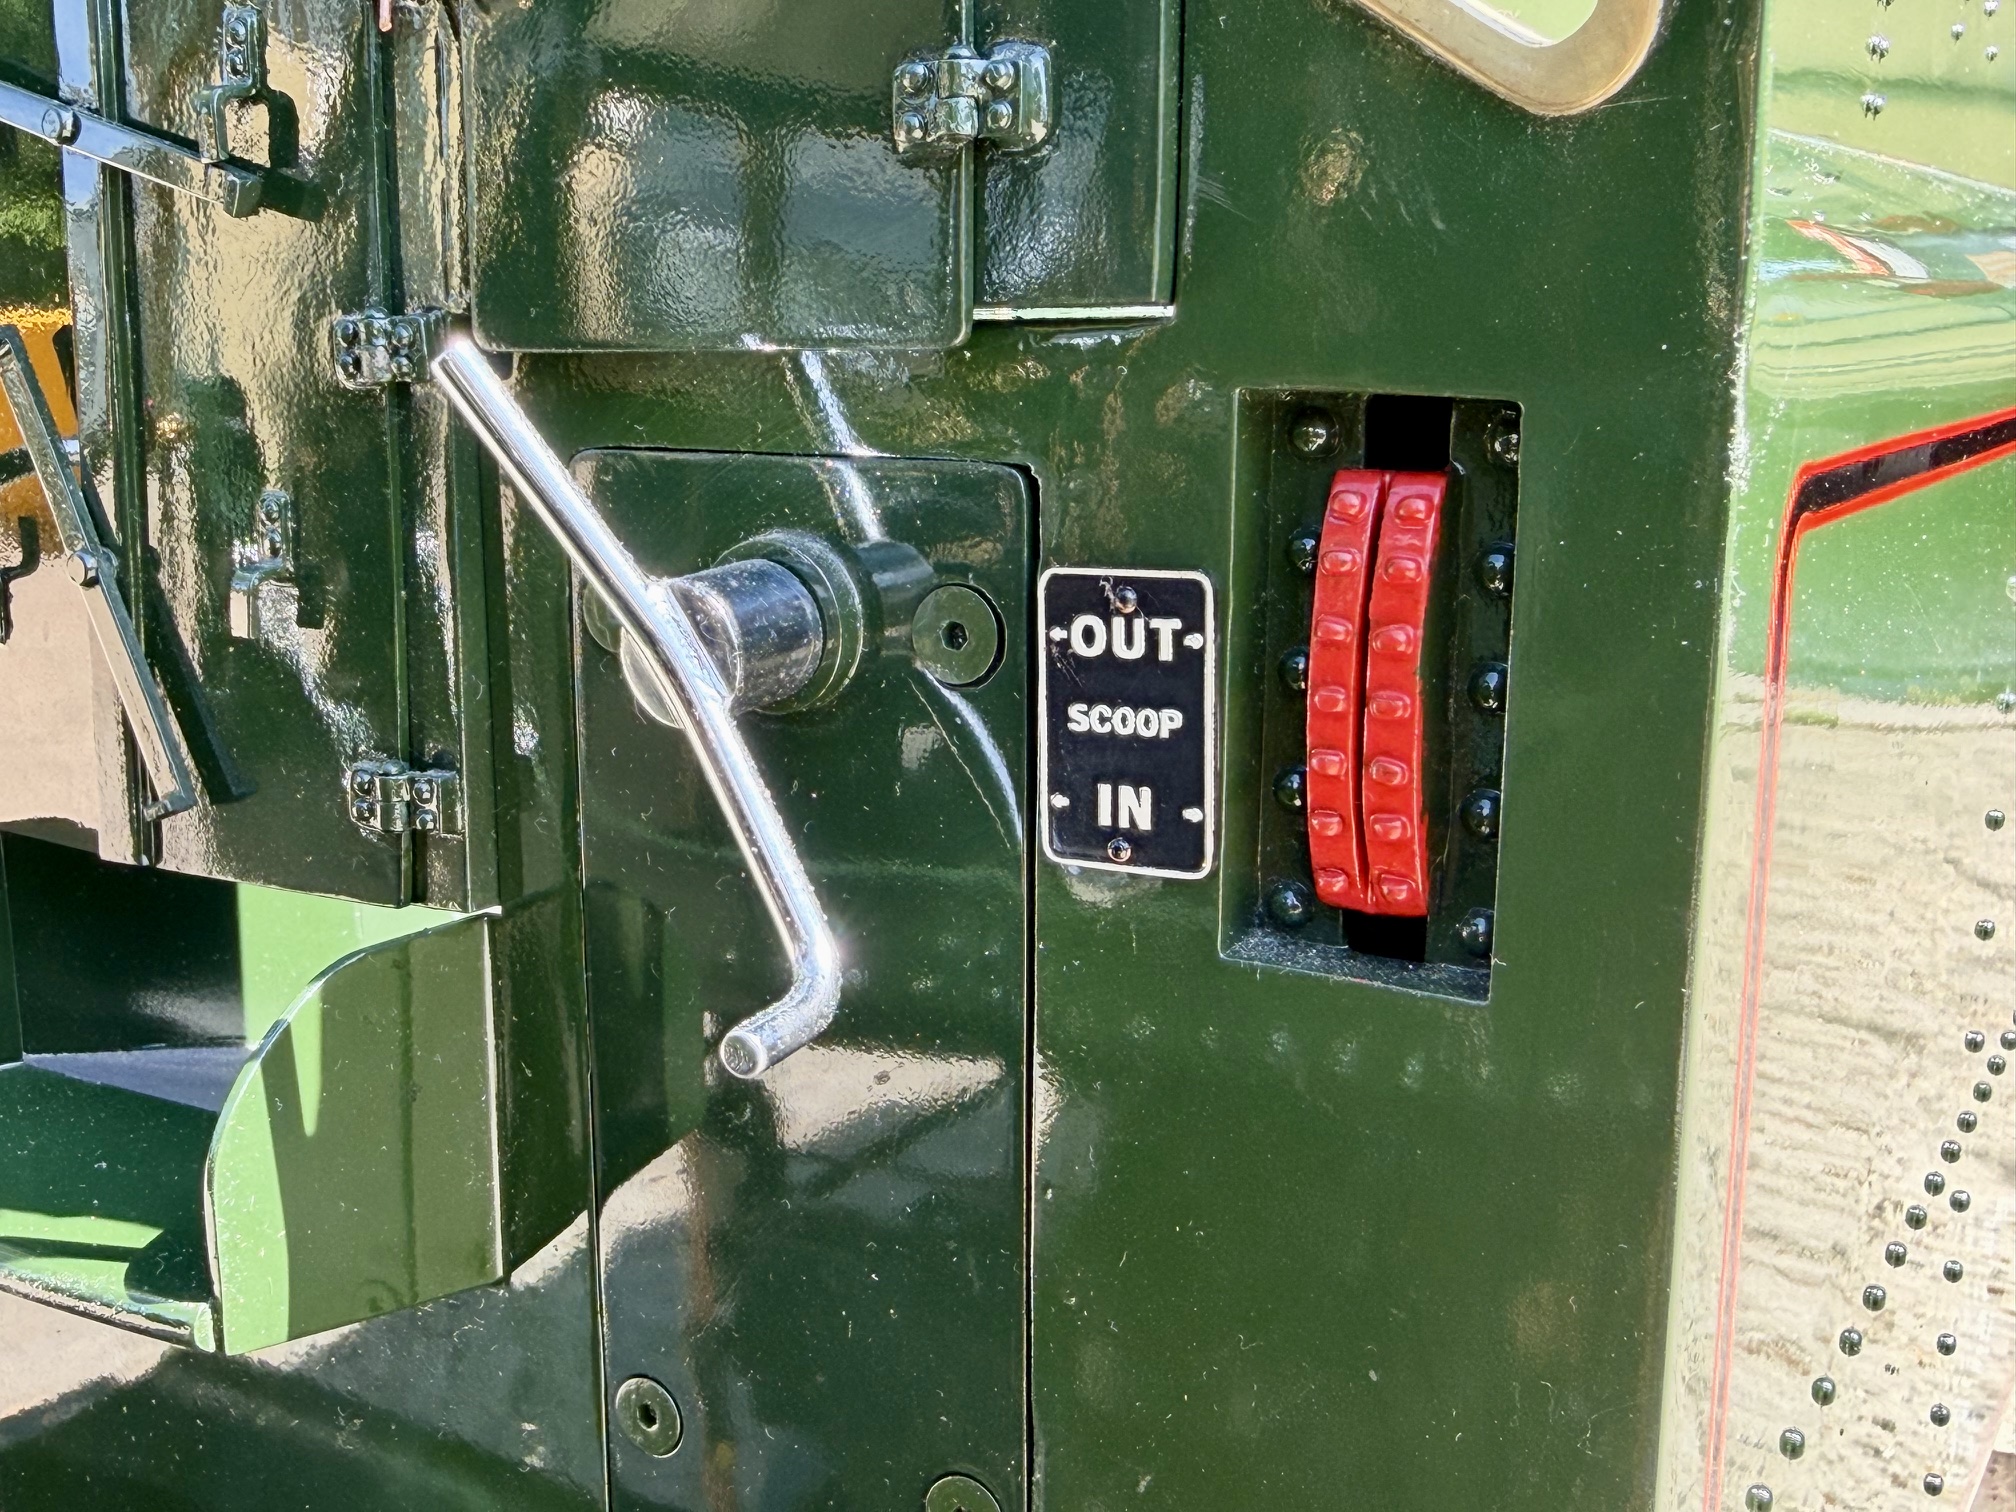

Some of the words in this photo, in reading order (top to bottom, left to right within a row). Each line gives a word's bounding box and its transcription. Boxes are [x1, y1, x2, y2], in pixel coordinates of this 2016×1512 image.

[1069, 614, 1183, 662] OUT
[1067, 703, 1183, 739] SCOOP
[1097, 783, 1152, 831] IN
